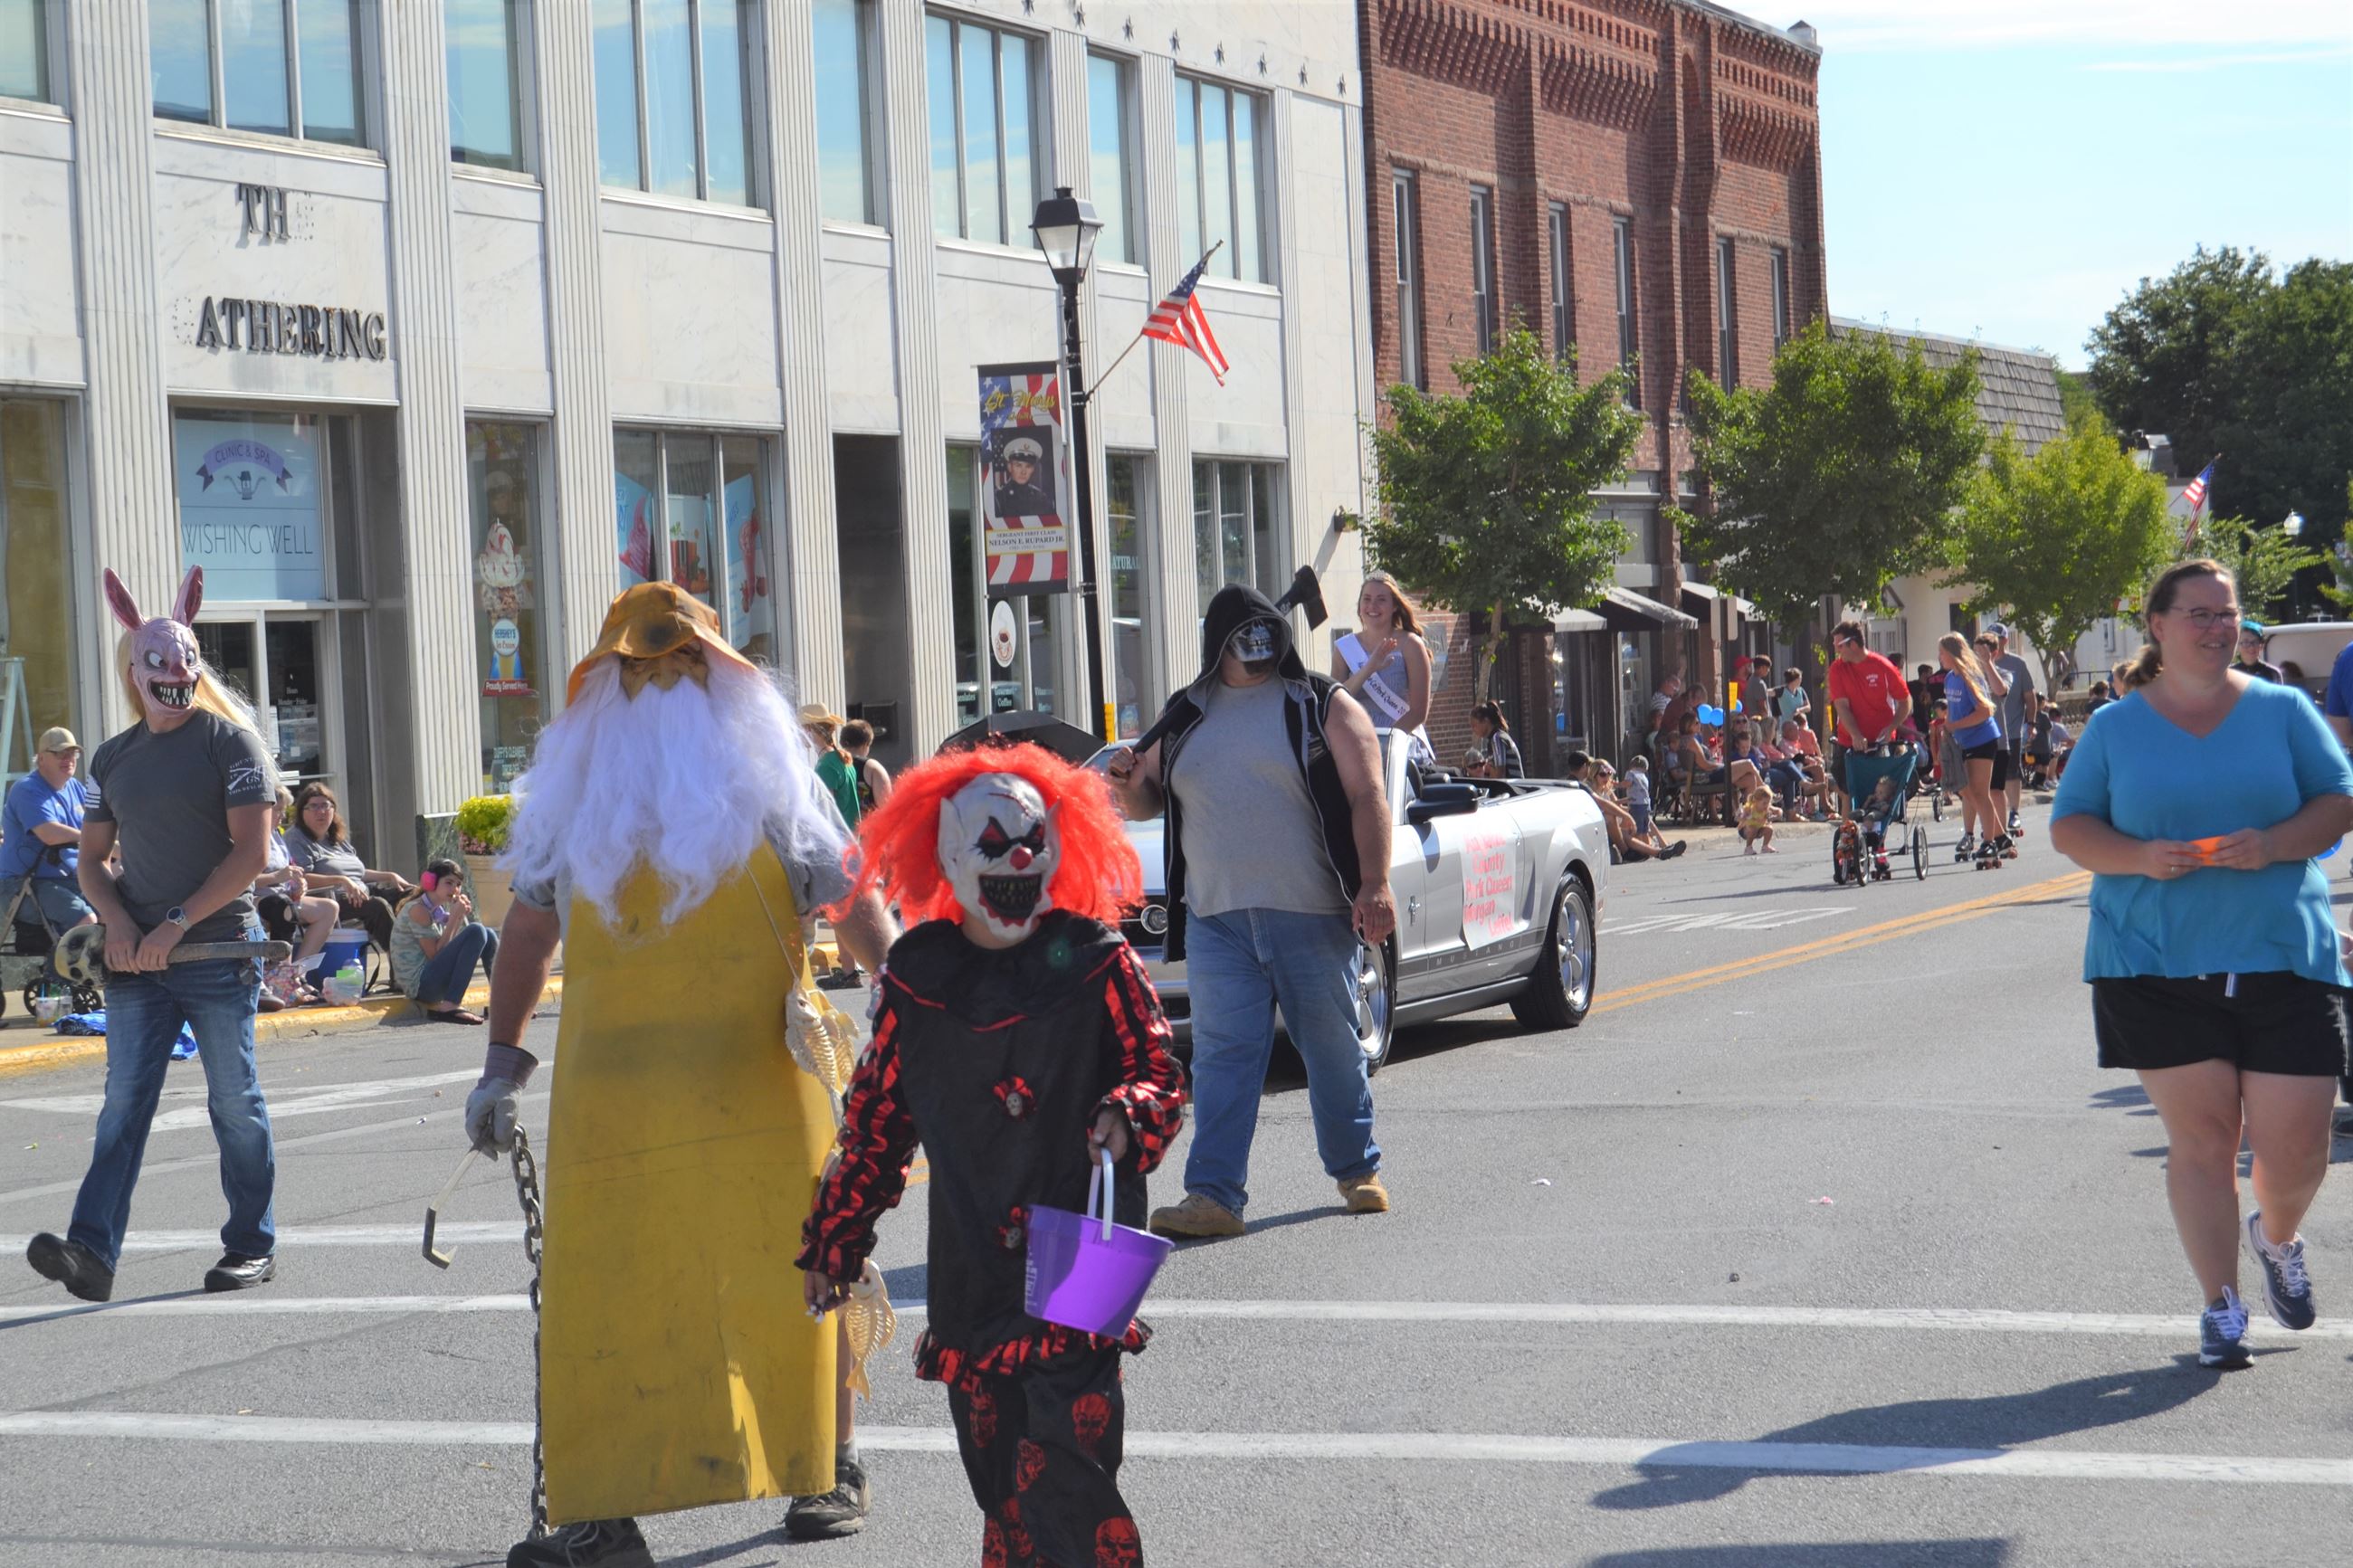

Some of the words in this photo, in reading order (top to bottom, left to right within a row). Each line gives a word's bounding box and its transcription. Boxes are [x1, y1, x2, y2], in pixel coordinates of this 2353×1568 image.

[196, 296, 386, 361] ATHERING
[214, 443, 243, 463] CLINIC
[245, 444, 252, 458] &
[253, 447, 272, 465] SPA
[181, 523, 262, 555] WISHING
[264, 524, 314, 555] WELL
[989, 538, 1017, 546] NELSON
[1025, 536, 1055, 545] RUPARD
[495, 628, 517, 639] HERSHEY'S
[997, 697, 1013, 708] Coffee
[1384, 696, 1398, 710] Queen
[1472, 852, 1506, 875] County
[1465, 878, 1484, 900] Pork
[1485, 875, 1513, 896] Queen
[1463, 898, 1496, 926] Morgan
